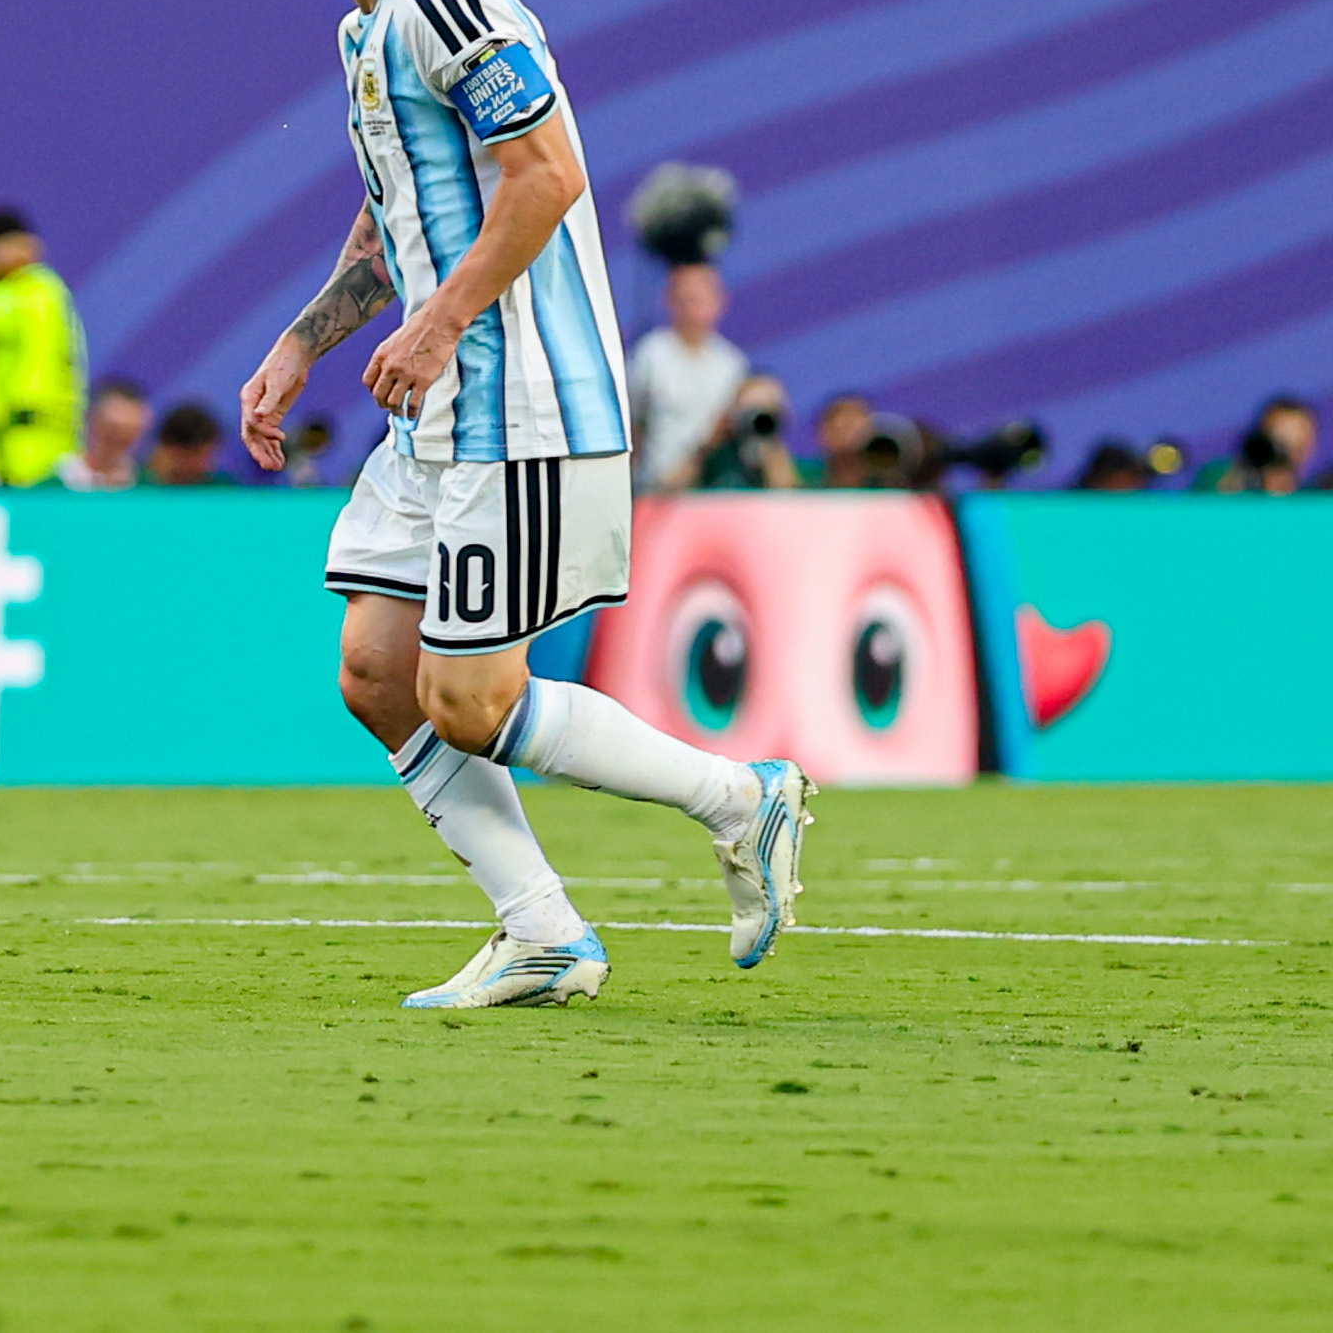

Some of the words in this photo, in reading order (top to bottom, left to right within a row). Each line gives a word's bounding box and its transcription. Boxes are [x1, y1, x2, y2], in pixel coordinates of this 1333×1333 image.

[462, 57, 509, 94] FOOTBALL
[468, 65, 516, 107] UNITES
[490, 76, 526, 109] World
[438, 540, 495, 623] 10
